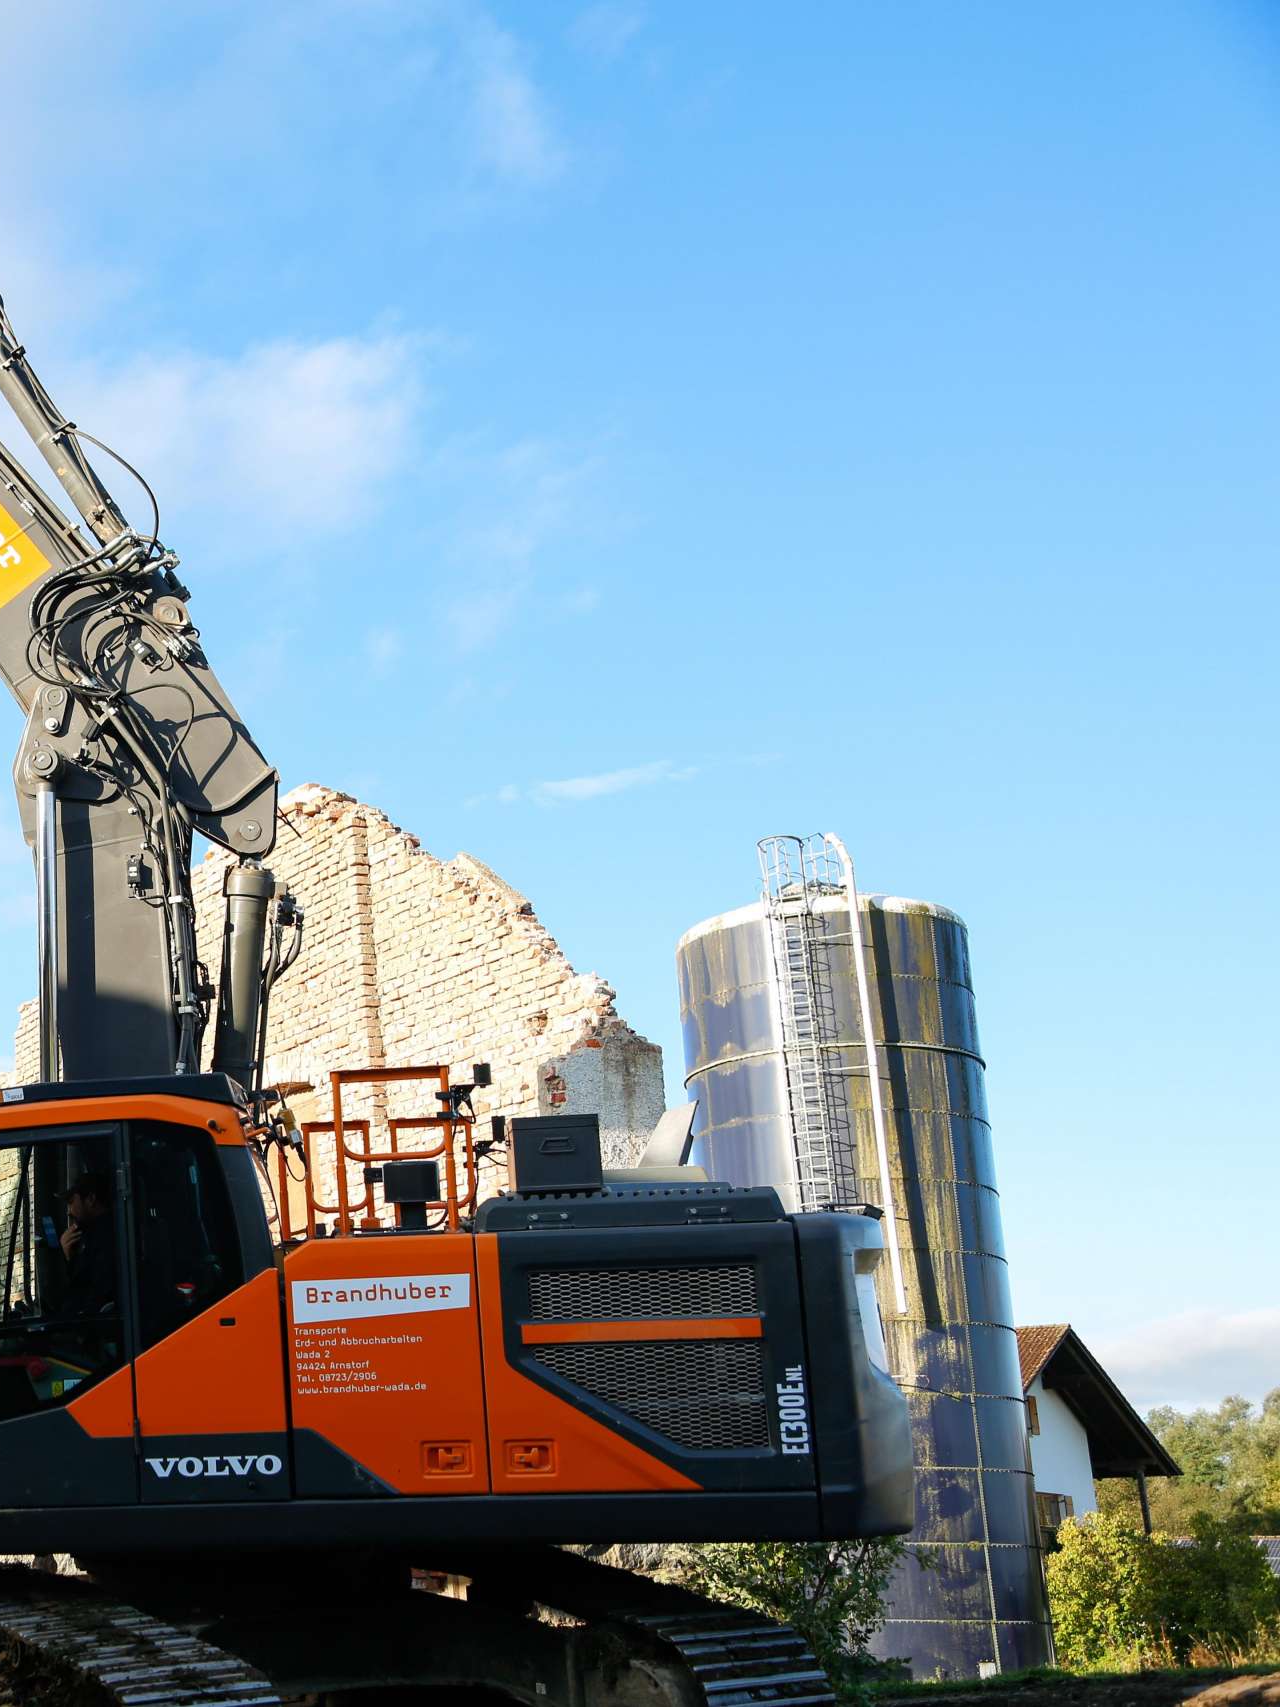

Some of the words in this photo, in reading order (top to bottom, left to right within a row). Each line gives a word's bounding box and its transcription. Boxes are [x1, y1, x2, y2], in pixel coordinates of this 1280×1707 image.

[306, 1282, 452, 1304] Brandhuber
[294, 1326, 347, 1336] Transporte
[295, 1339, 316, 1348] Erd-
[318, 1338, 337, 1347] und
[341, 1335, 423, 1346] Abbrucharbeiten
[295, 1350, 321, 1359] Wada
[324, 1350, 331, 1358] 2
[296, 1362, 326, 1371] 94424
[330, 1360, 370, 1370] Arnstorf
[297, 1374, 315, 1383] Tel.
[319, 1371, 377, 1382] 08723/2906
[297, 1382, 427, 1395] www.brandhuber-wada.de
[145, 1454, 282, 1478] VOLVO
